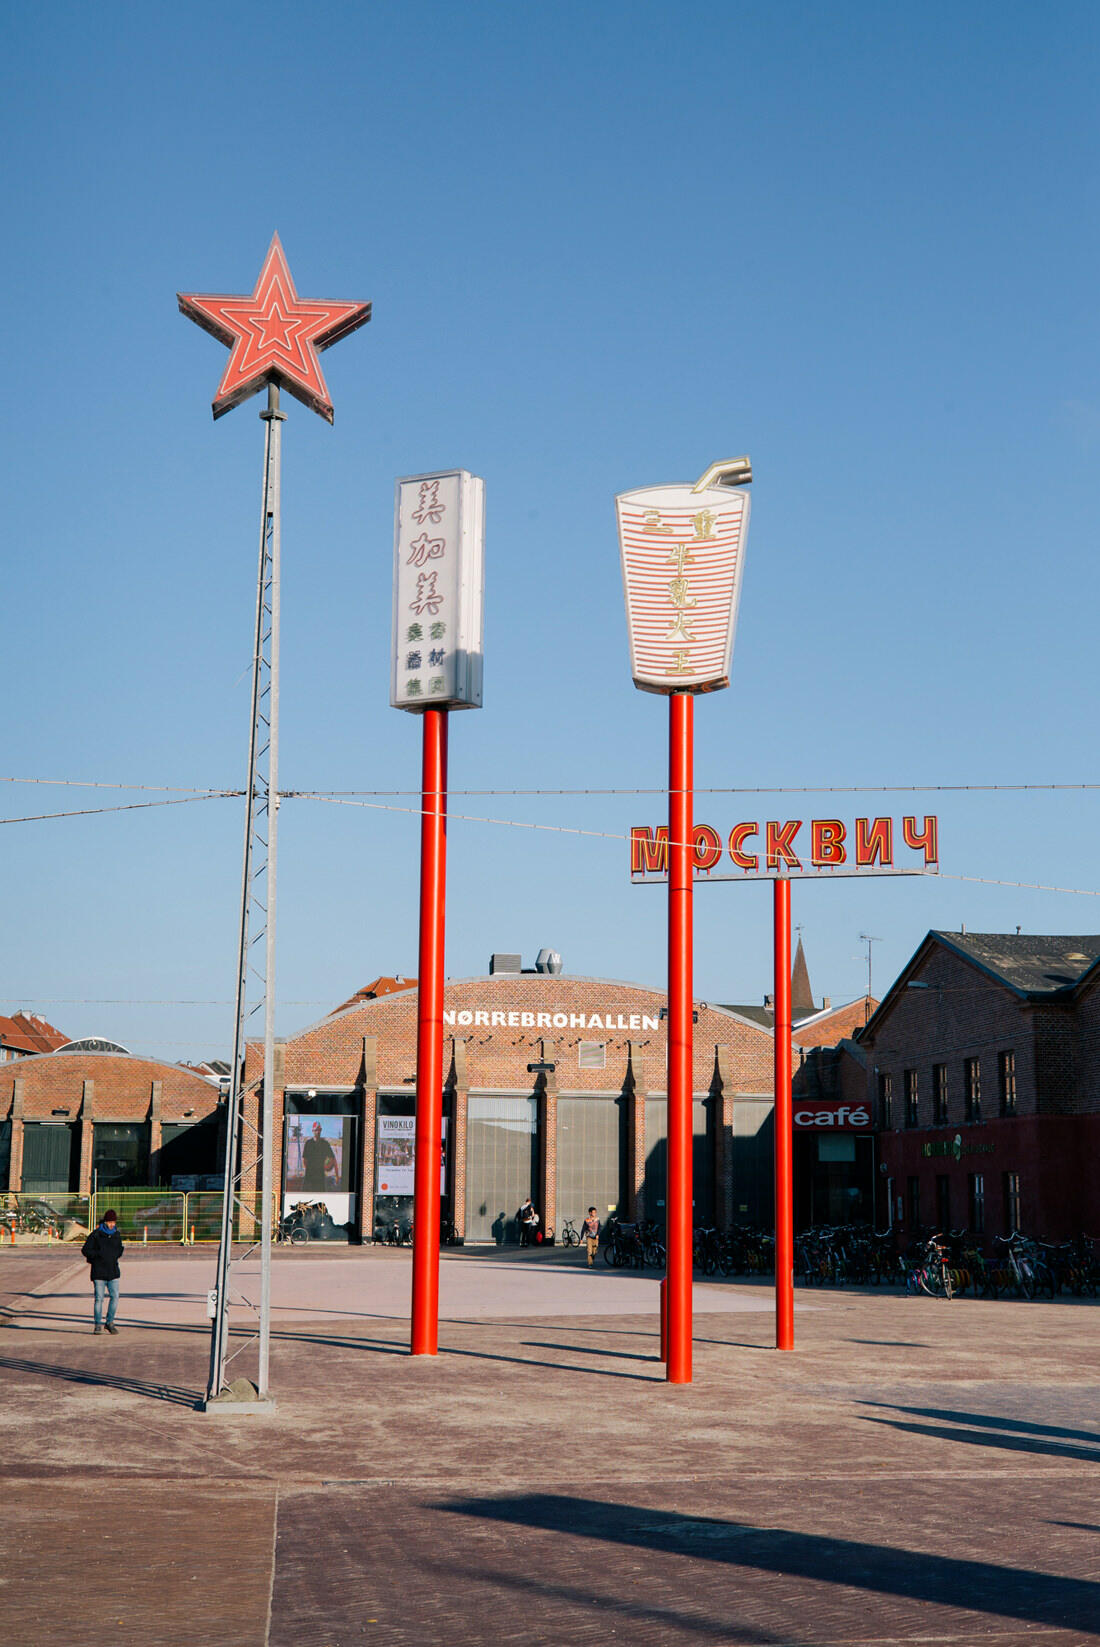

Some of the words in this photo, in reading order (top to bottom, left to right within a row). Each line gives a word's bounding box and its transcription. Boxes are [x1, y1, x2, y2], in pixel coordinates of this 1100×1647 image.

[642, 509, 719, 541] 三重
[665, 543, 698, 676] 牛乳大王
[630, 815, 938, 872] МОСКВИЧ
[443, 1010, 659, 1031] NØRREBROHALLEN
[794, 1106, 869, 1126] café
